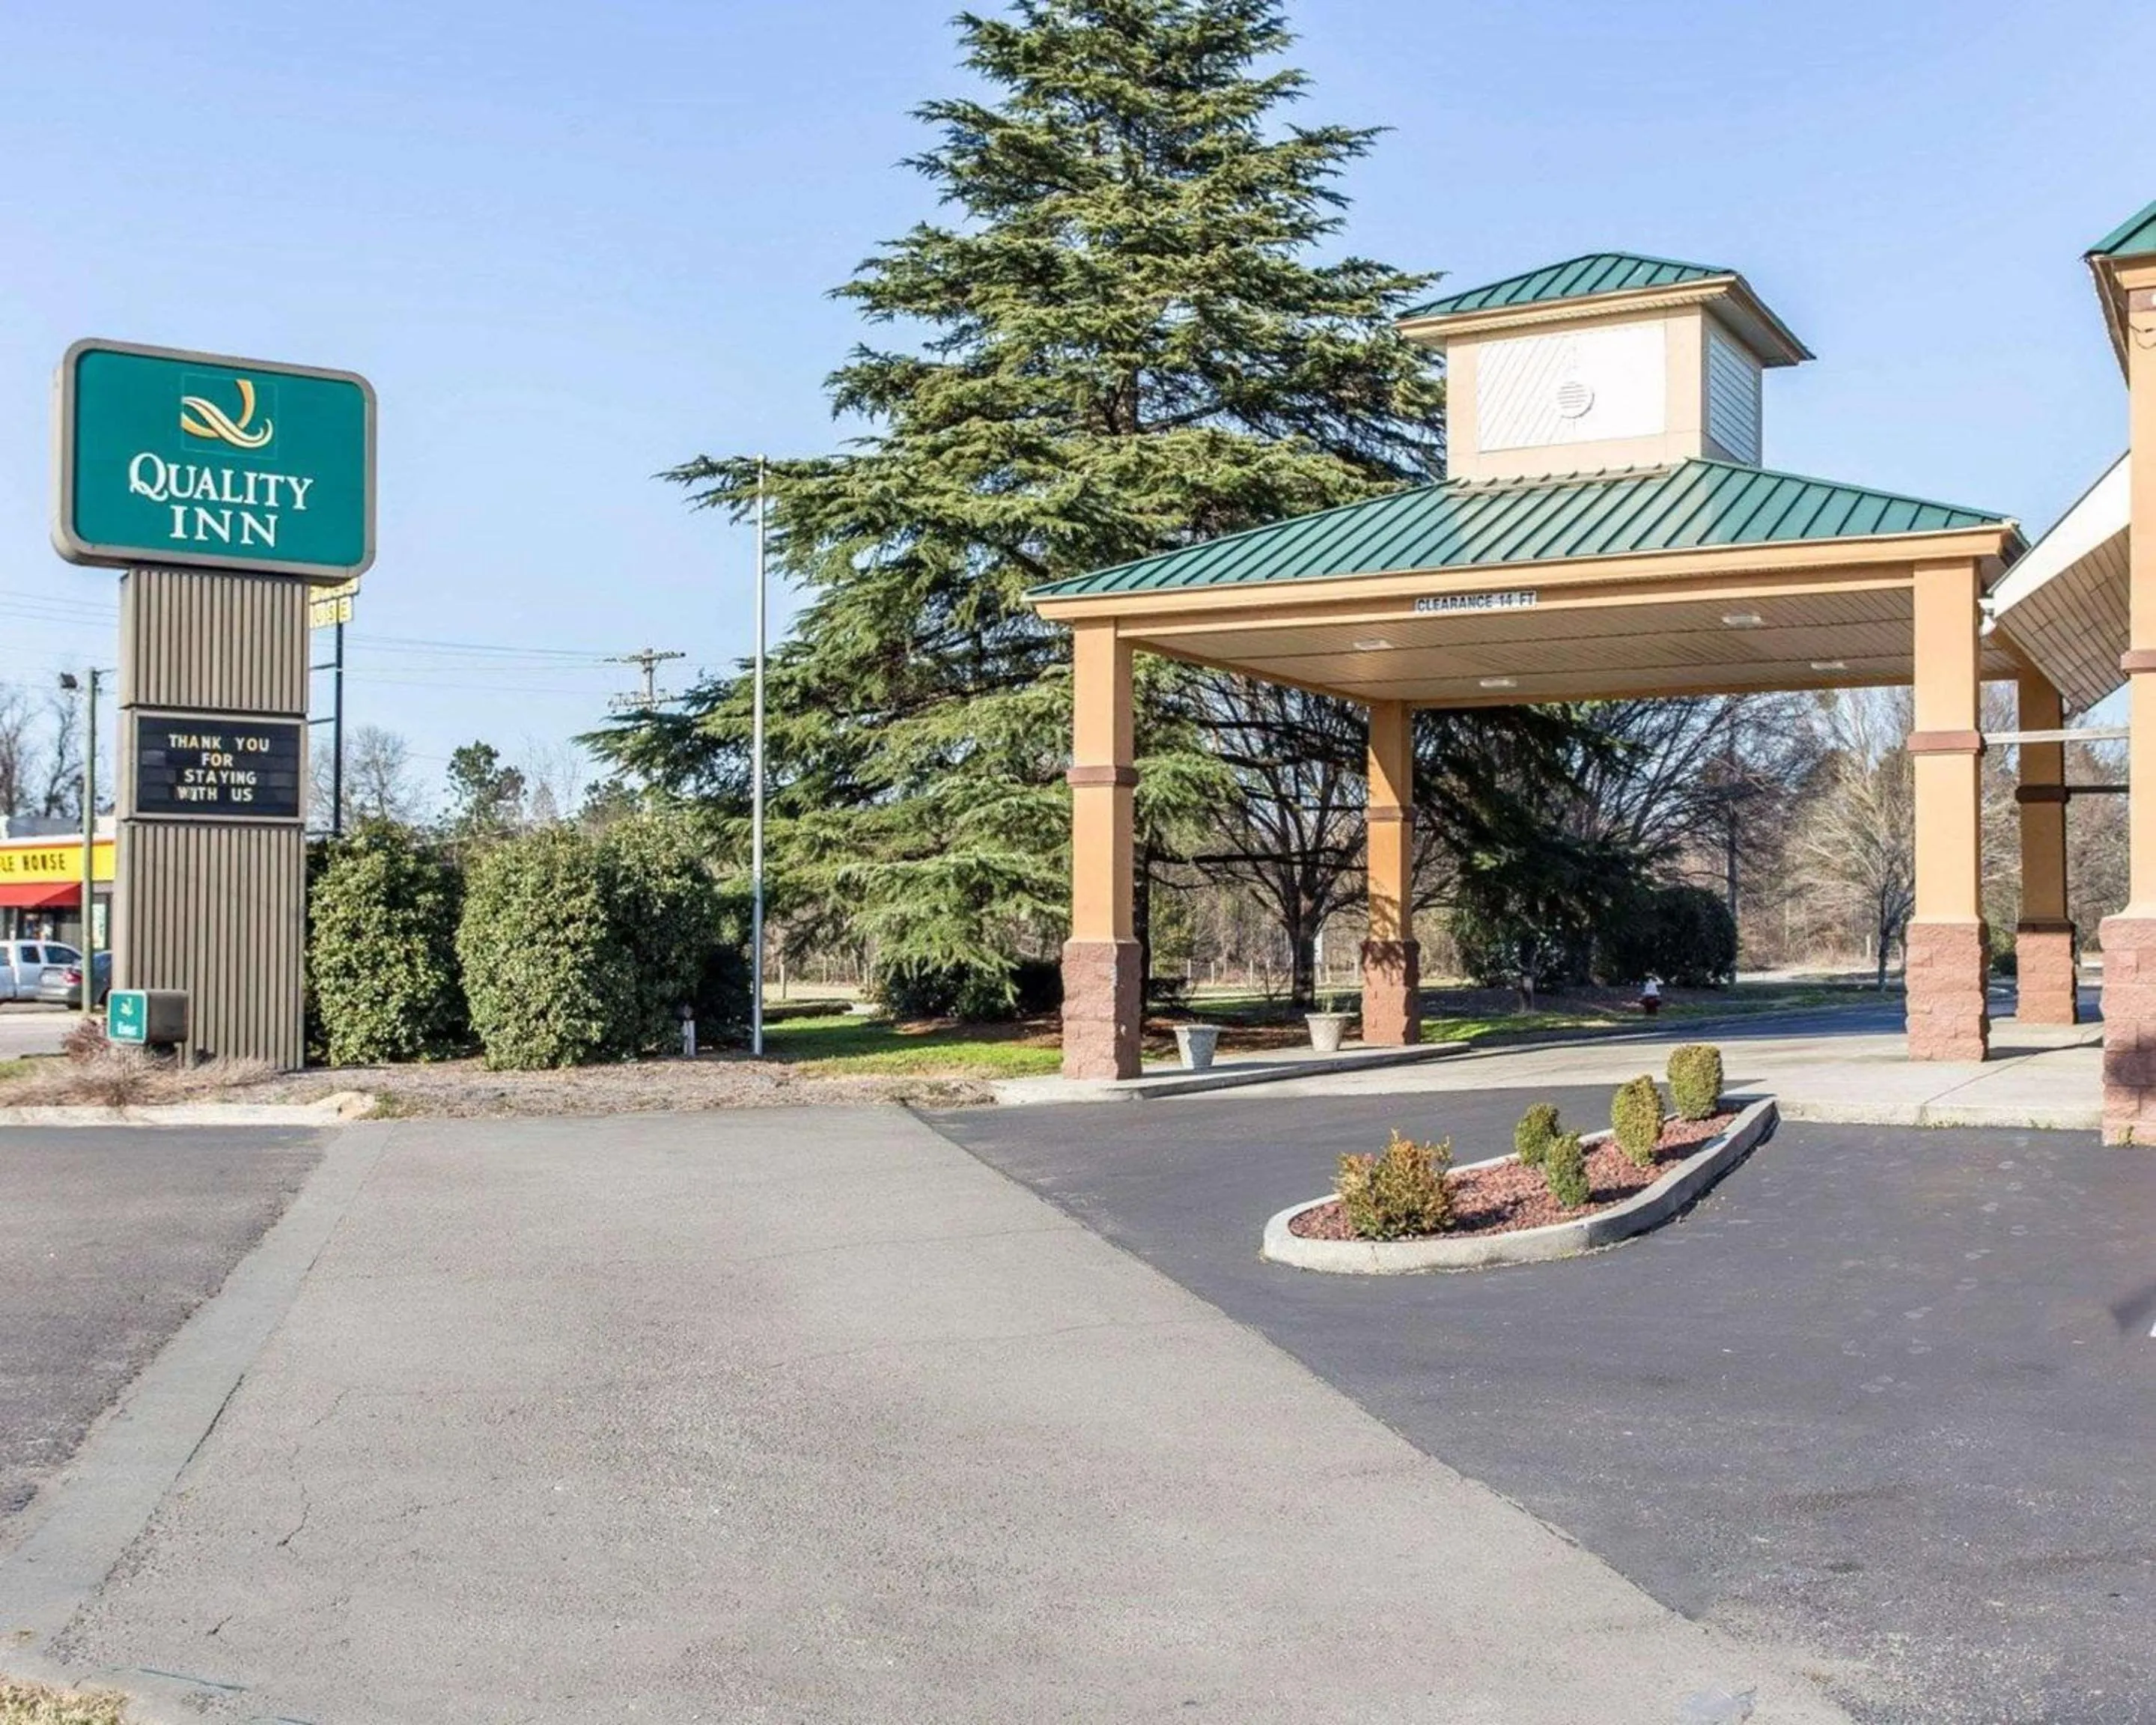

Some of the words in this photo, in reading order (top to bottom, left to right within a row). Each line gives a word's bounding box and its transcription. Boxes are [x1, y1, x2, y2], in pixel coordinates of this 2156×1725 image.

[129, 452, 314, 510] QUALITY
[169, 505, 278, 547] INN
[1417, 594, 1493, 612] CLEARANCE
[1499, 594, 1512, 607] 14
[1519, 592, 1535, 606] FT
[168, 734, 222, 749] THANK
[234, 737, 270, 752] YOU
[201, 753, 234, 767] FOR
[184, 769, 257, 785] STAYING
[177, 786, 218, 801] WITH
[231, 788, 253, 802] US
[22, 853, 66, 871] HOUSE
